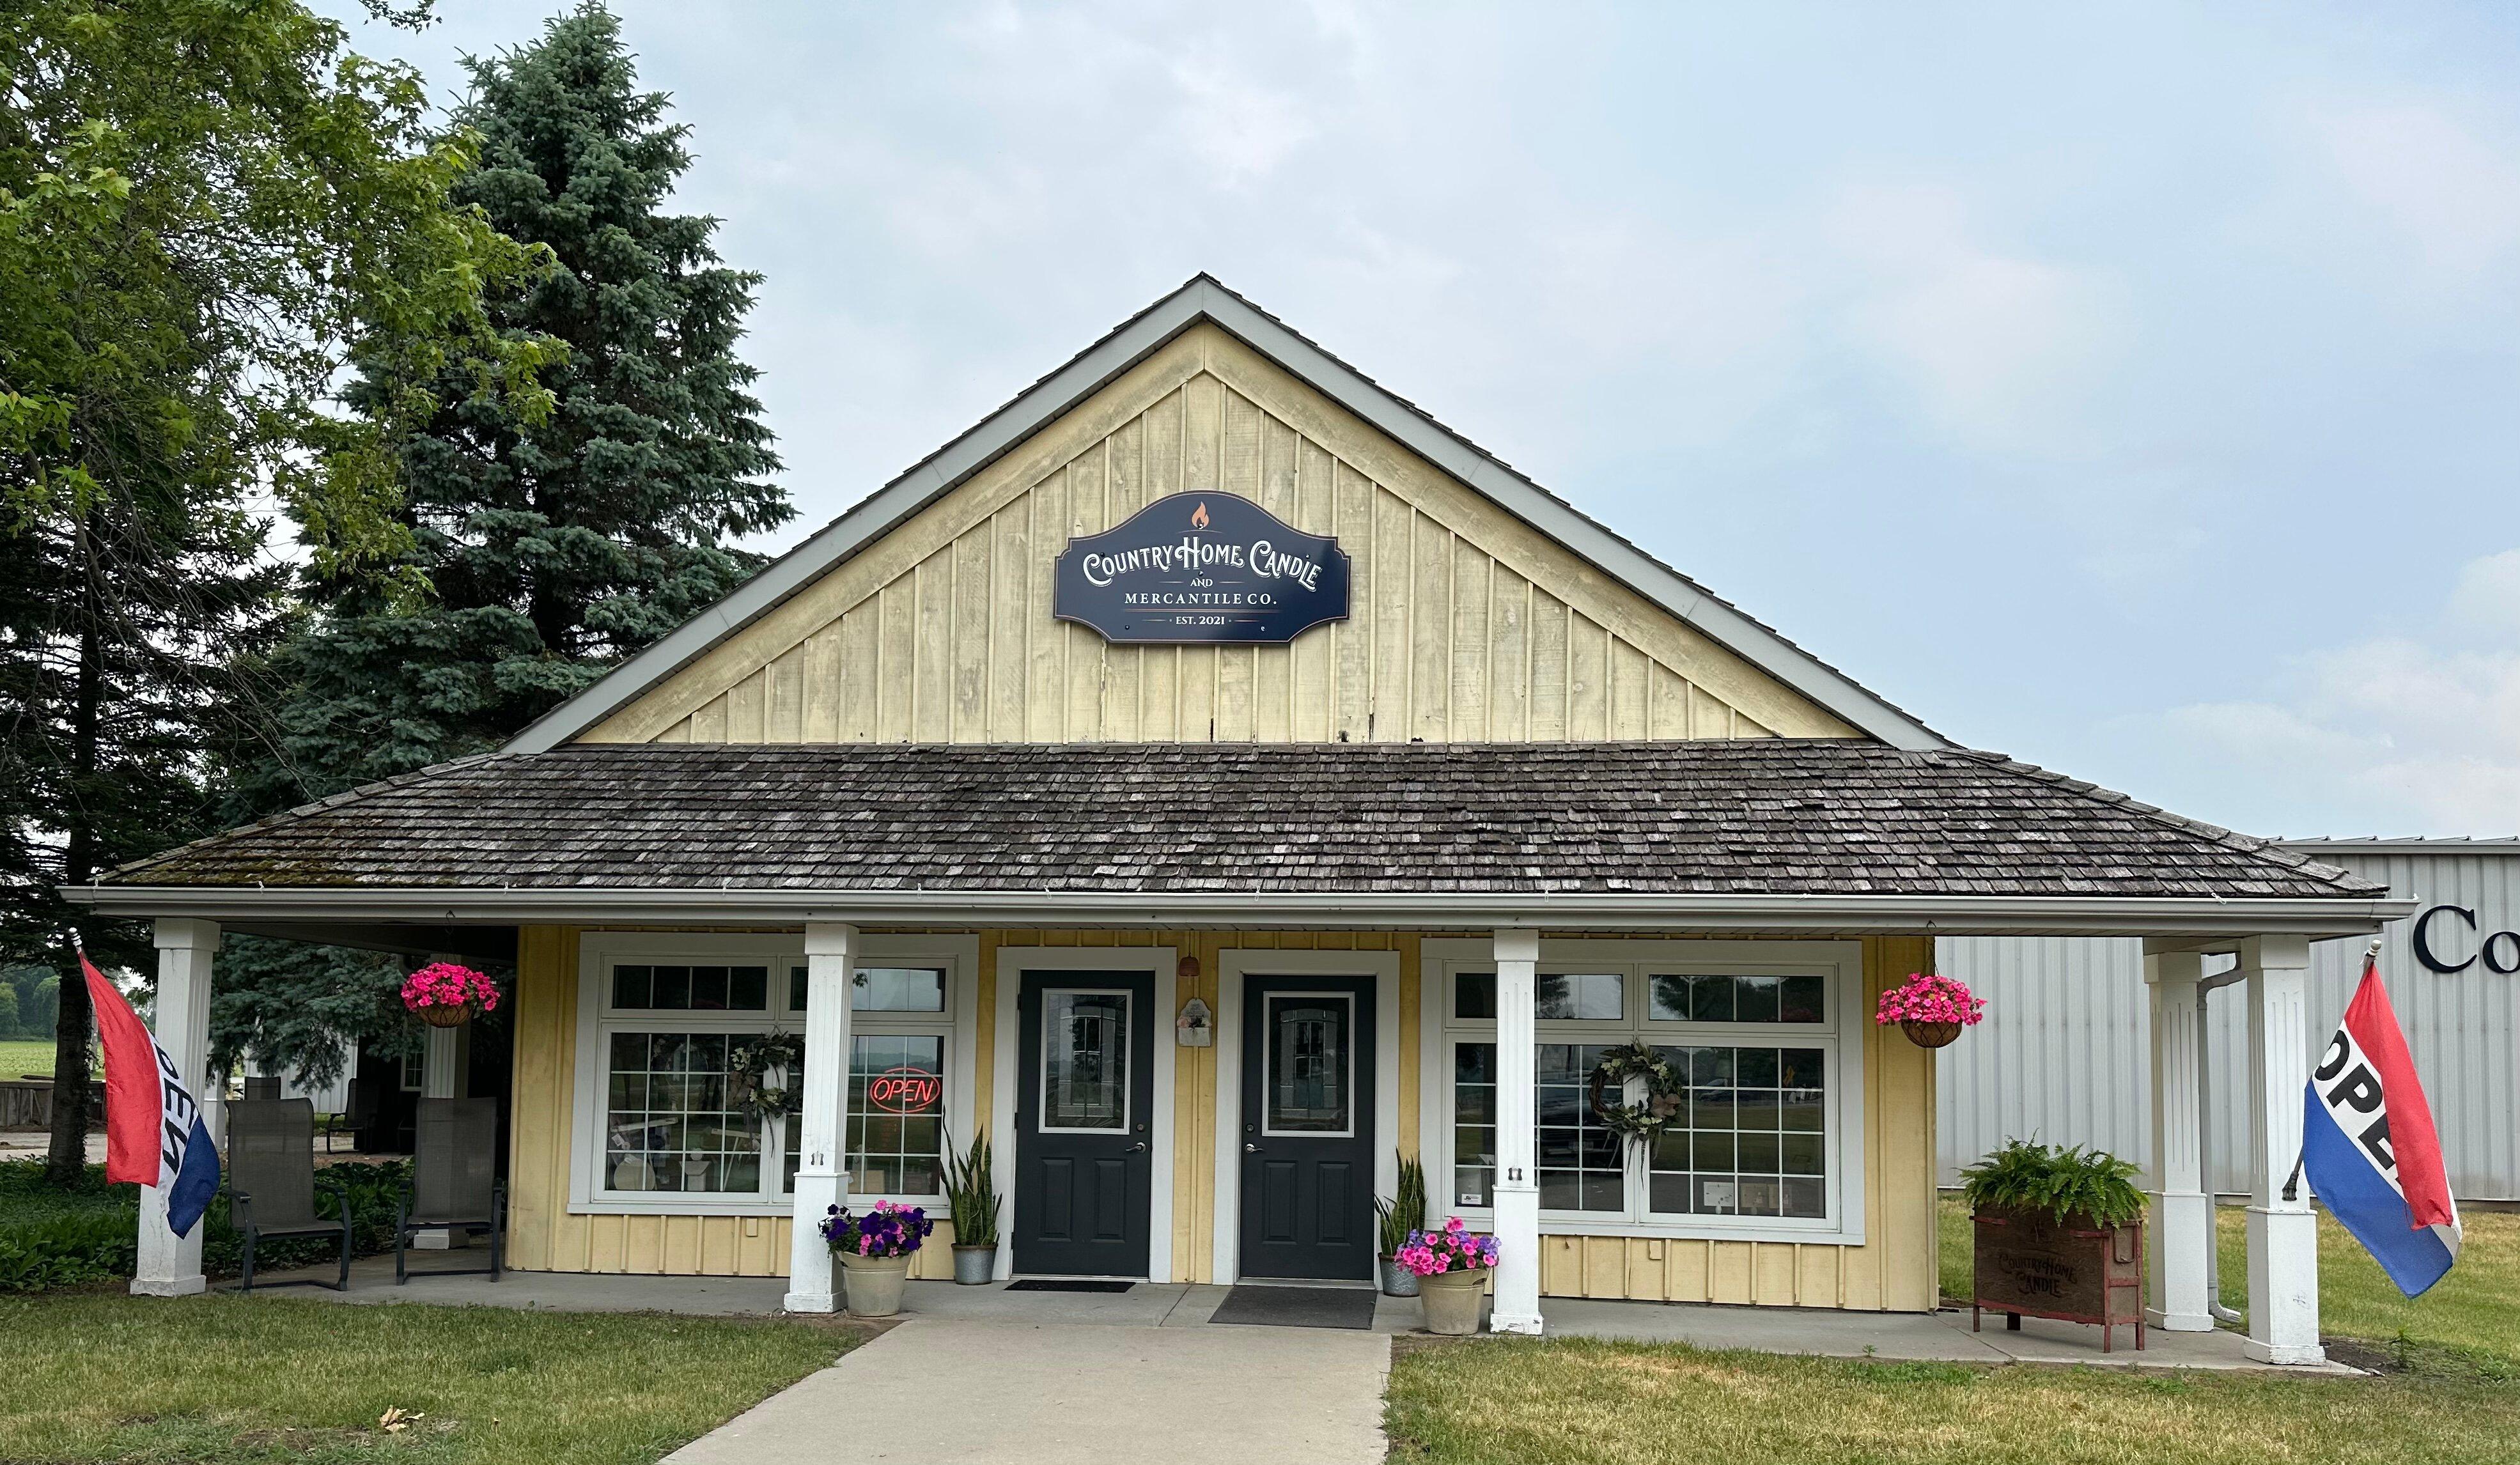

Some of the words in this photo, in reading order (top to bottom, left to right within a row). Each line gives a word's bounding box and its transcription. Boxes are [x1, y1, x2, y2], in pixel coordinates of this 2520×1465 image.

[1190, 578, 1213, 588] AND
[1124, 593, 1241, 605] MERCANTILE
[1247, 593, 1278, 605] CO.
[1176, 616, 1197, 625] EST.
[1199, 616, 1225, 625] 2021
[874, 1080, 934, 1102] OPEN
[2315, 1029, 2404, 1188] OPE
